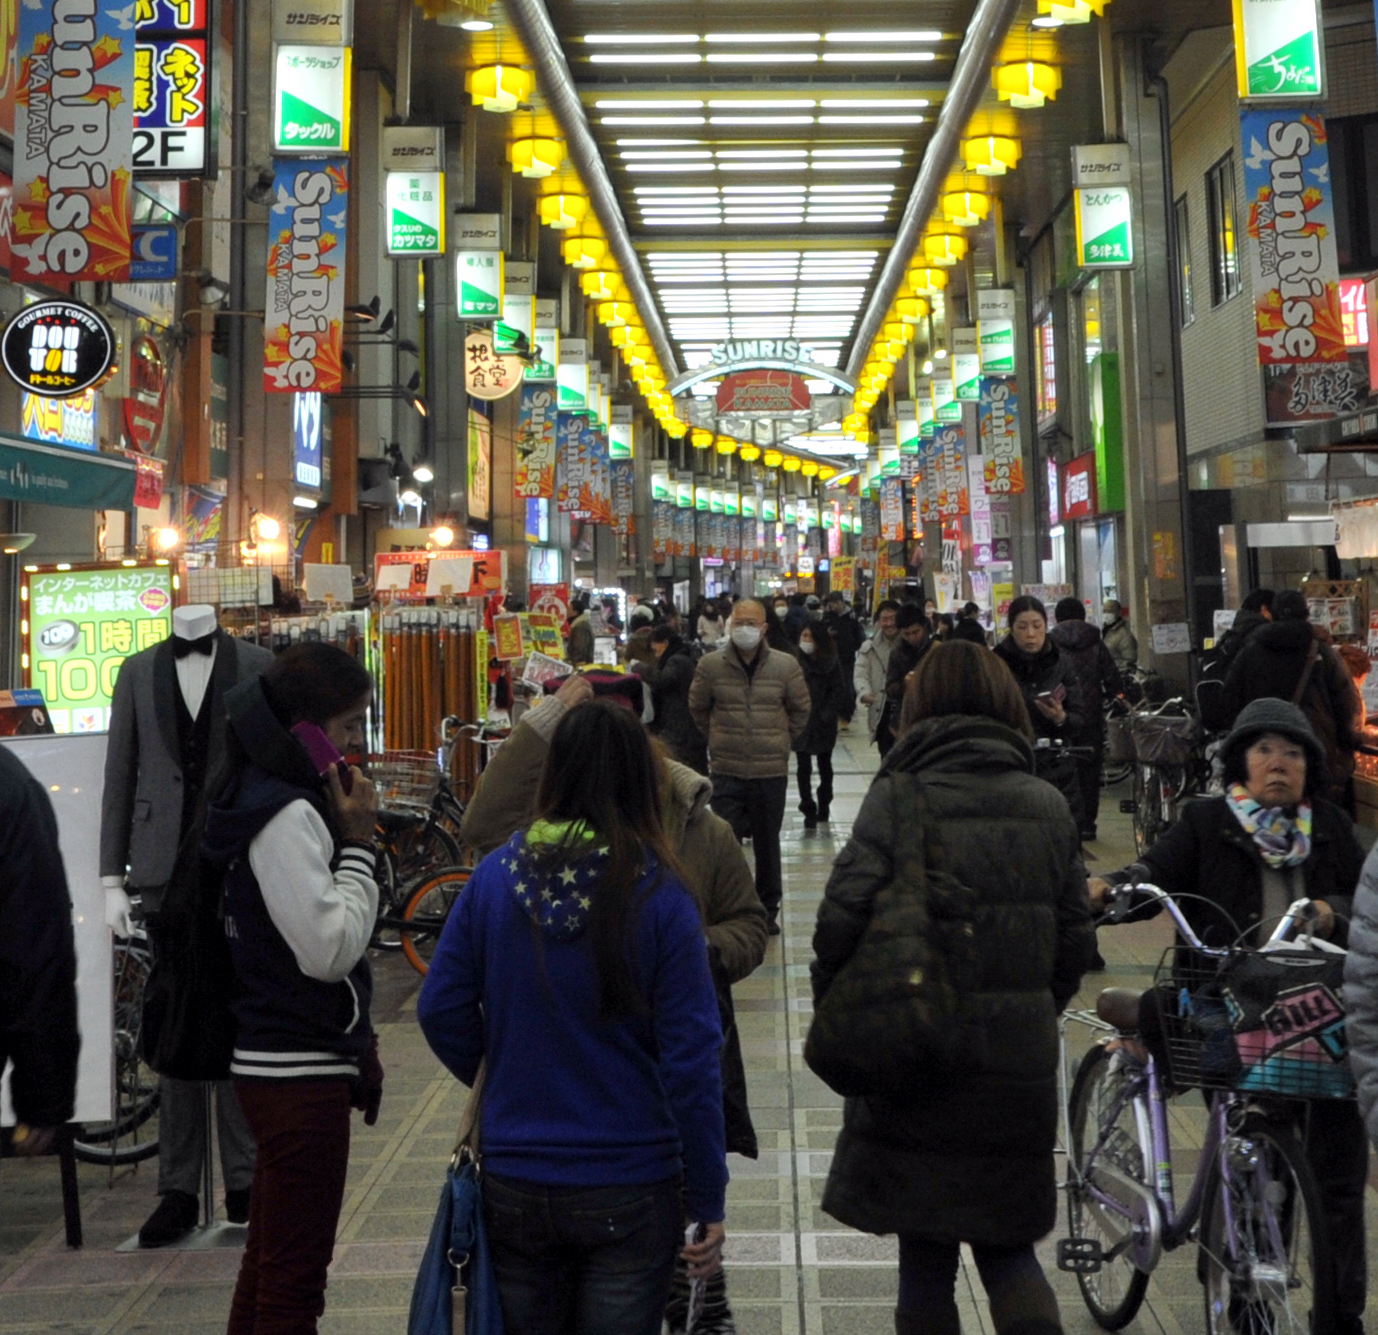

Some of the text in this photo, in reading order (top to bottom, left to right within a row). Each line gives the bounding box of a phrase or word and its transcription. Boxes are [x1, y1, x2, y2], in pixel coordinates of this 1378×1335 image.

[285, 12, 342, 25] サンライズ
[25, 53, 50, 160] KAMATA
[283, 121, 336, 140] タックル
[132, 131, 187, 169] 2F
[1084, 193, 1122, 206] とんかつ
[393, 234, 437, 248] カツマタ
[1255, 199, 1277, 278] KAMATA
[1266, 120, 1322, 359] SunRise
[273, 243, 289, 314] KAMATA
[287, 169, 333, 389] SunRise
[17, 306, 99, 333] GOURMET COFFEE
[711, 339, 815, 365] SUNRISE
[468, 365, 507, 388] 食堂
[990, 383, 1014, 493] SunRise
[33, 572, 169, 593] インターネットカフェ
[34, 589, 137, 615] まんが喫茶
[43, 622, 75, 644] 100
